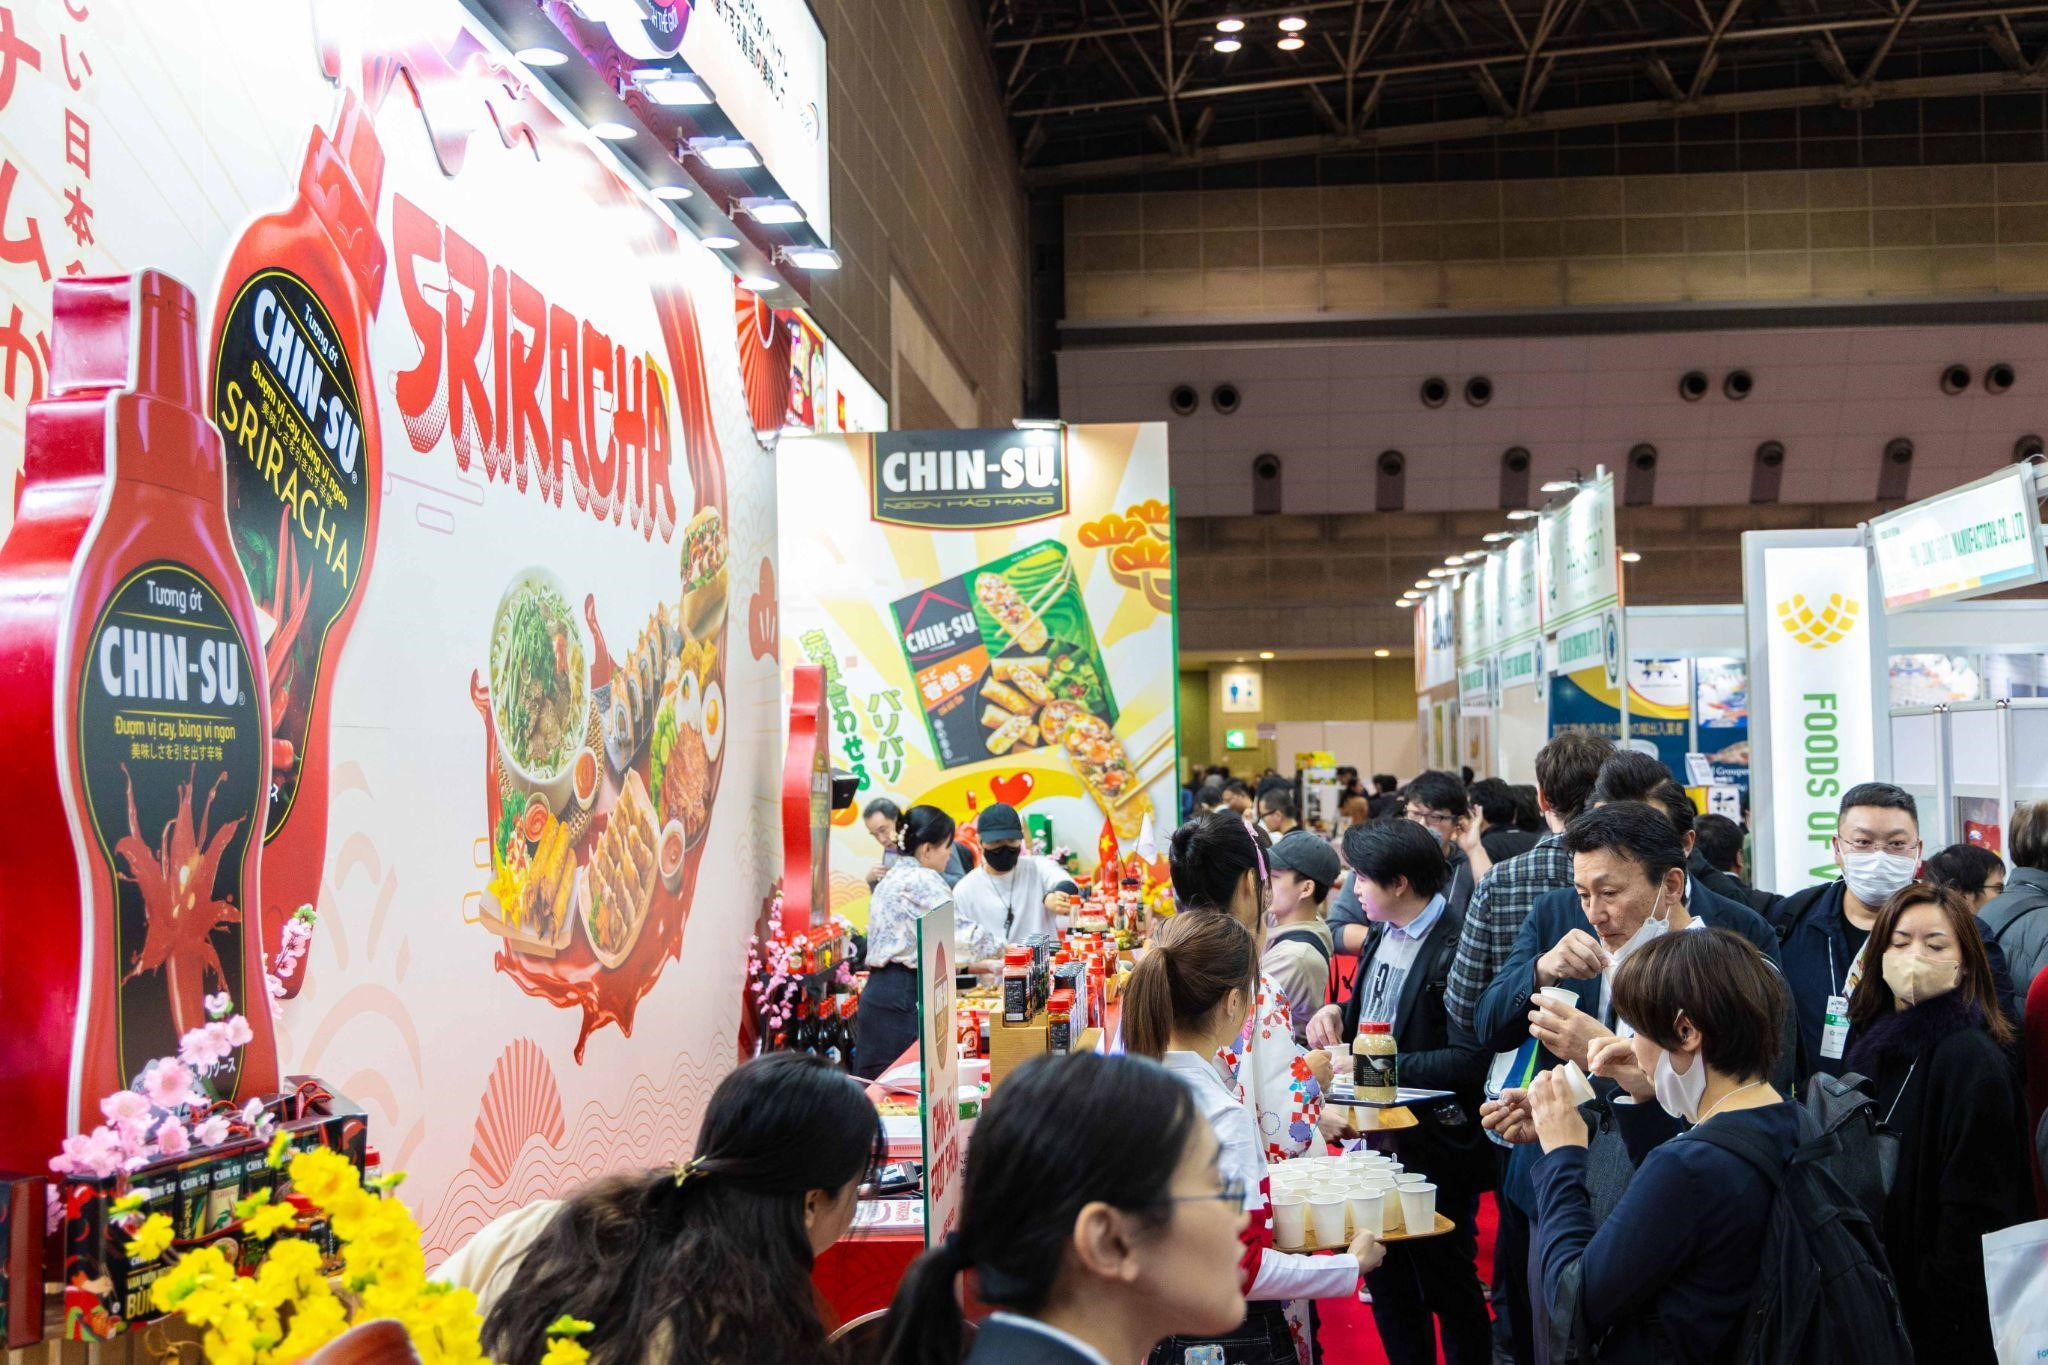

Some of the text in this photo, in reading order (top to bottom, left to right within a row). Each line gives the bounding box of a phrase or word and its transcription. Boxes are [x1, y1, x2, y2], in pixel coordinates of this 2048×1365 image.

[254, 288, 360, 474] CHIN-SU
[393, 192, 676, 543] SRIRACHA
[221, 381, 348, 589] SRIRACHA
[329, 479, 348, 511] ngon
[883, 447, 1056, 492] CHIN-SU
[147, 580, 202, 614] Tương ớt
[906, 612, 976, 653] CHIN-SU
[100, 626, 239, 705] CHIN-SU
[179, 720, 202, 741] bùng
[213, 726, 235, 743] ngon
[868, 690, 904, 783] バリバリ
[1803, 693, 1840, 798] FOODS
